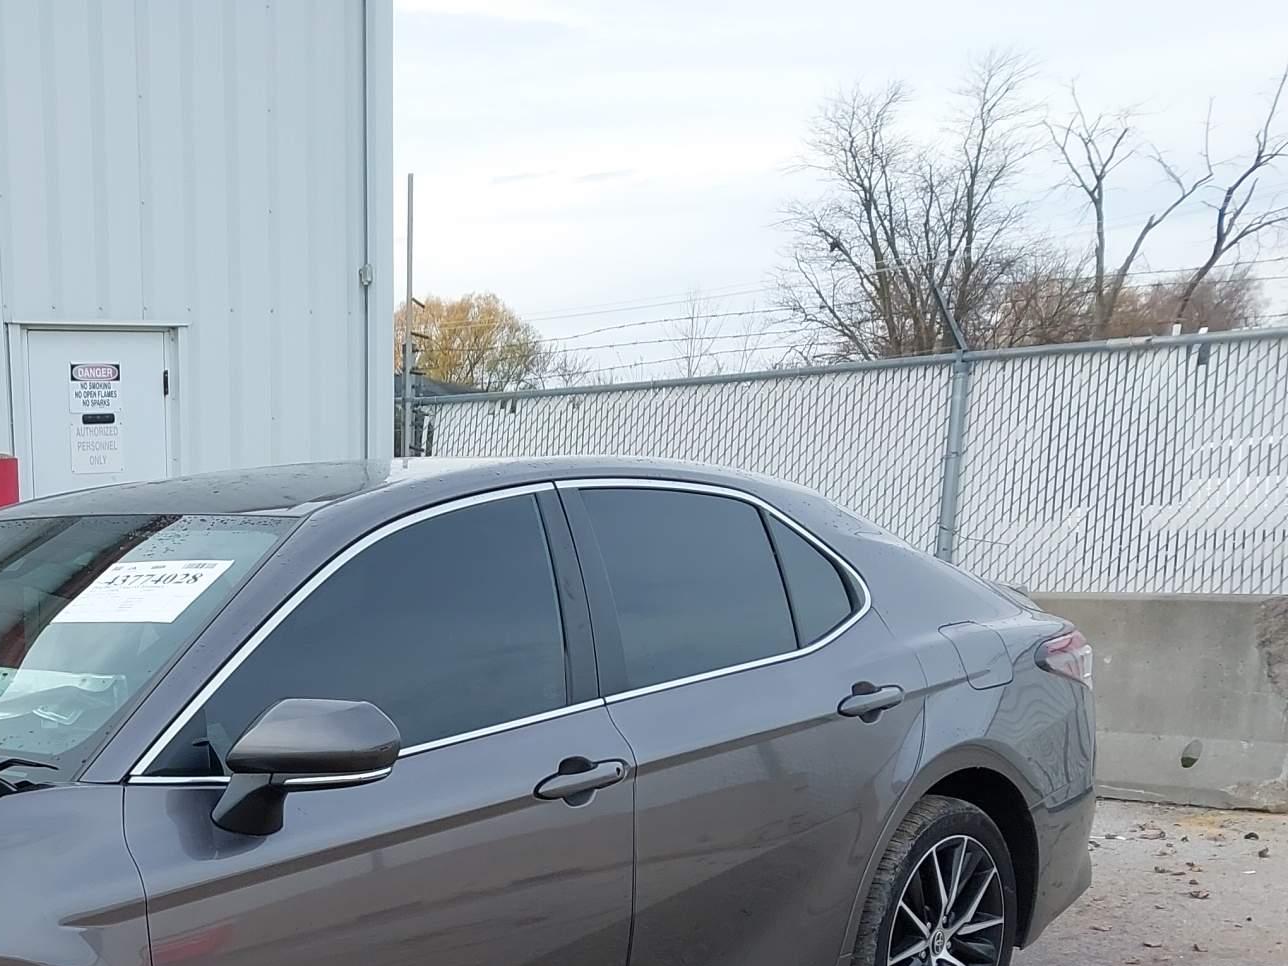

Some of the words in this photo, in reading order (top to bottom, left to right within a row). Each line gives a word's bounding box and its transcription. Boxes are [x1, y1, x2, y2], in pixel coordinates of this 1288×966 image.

[77, 367, 113, 378] DANGER
[80, 382, 88, 390] NO
[89, 382, 112, 390] SMOKING
[74, 390, 82, 399] NO
[83, 390, 96, 399] OPEN
[98, 390, 117, 398] FLAMES
[82, 399, 90, 407] NO
[91, 399, 110, 407] SPARKS
[76, 426, 118, 437] AUTHORIZED
[77, 440, 117, 451] PERSONNEL
[89, 455, 107, 465] ONLY
